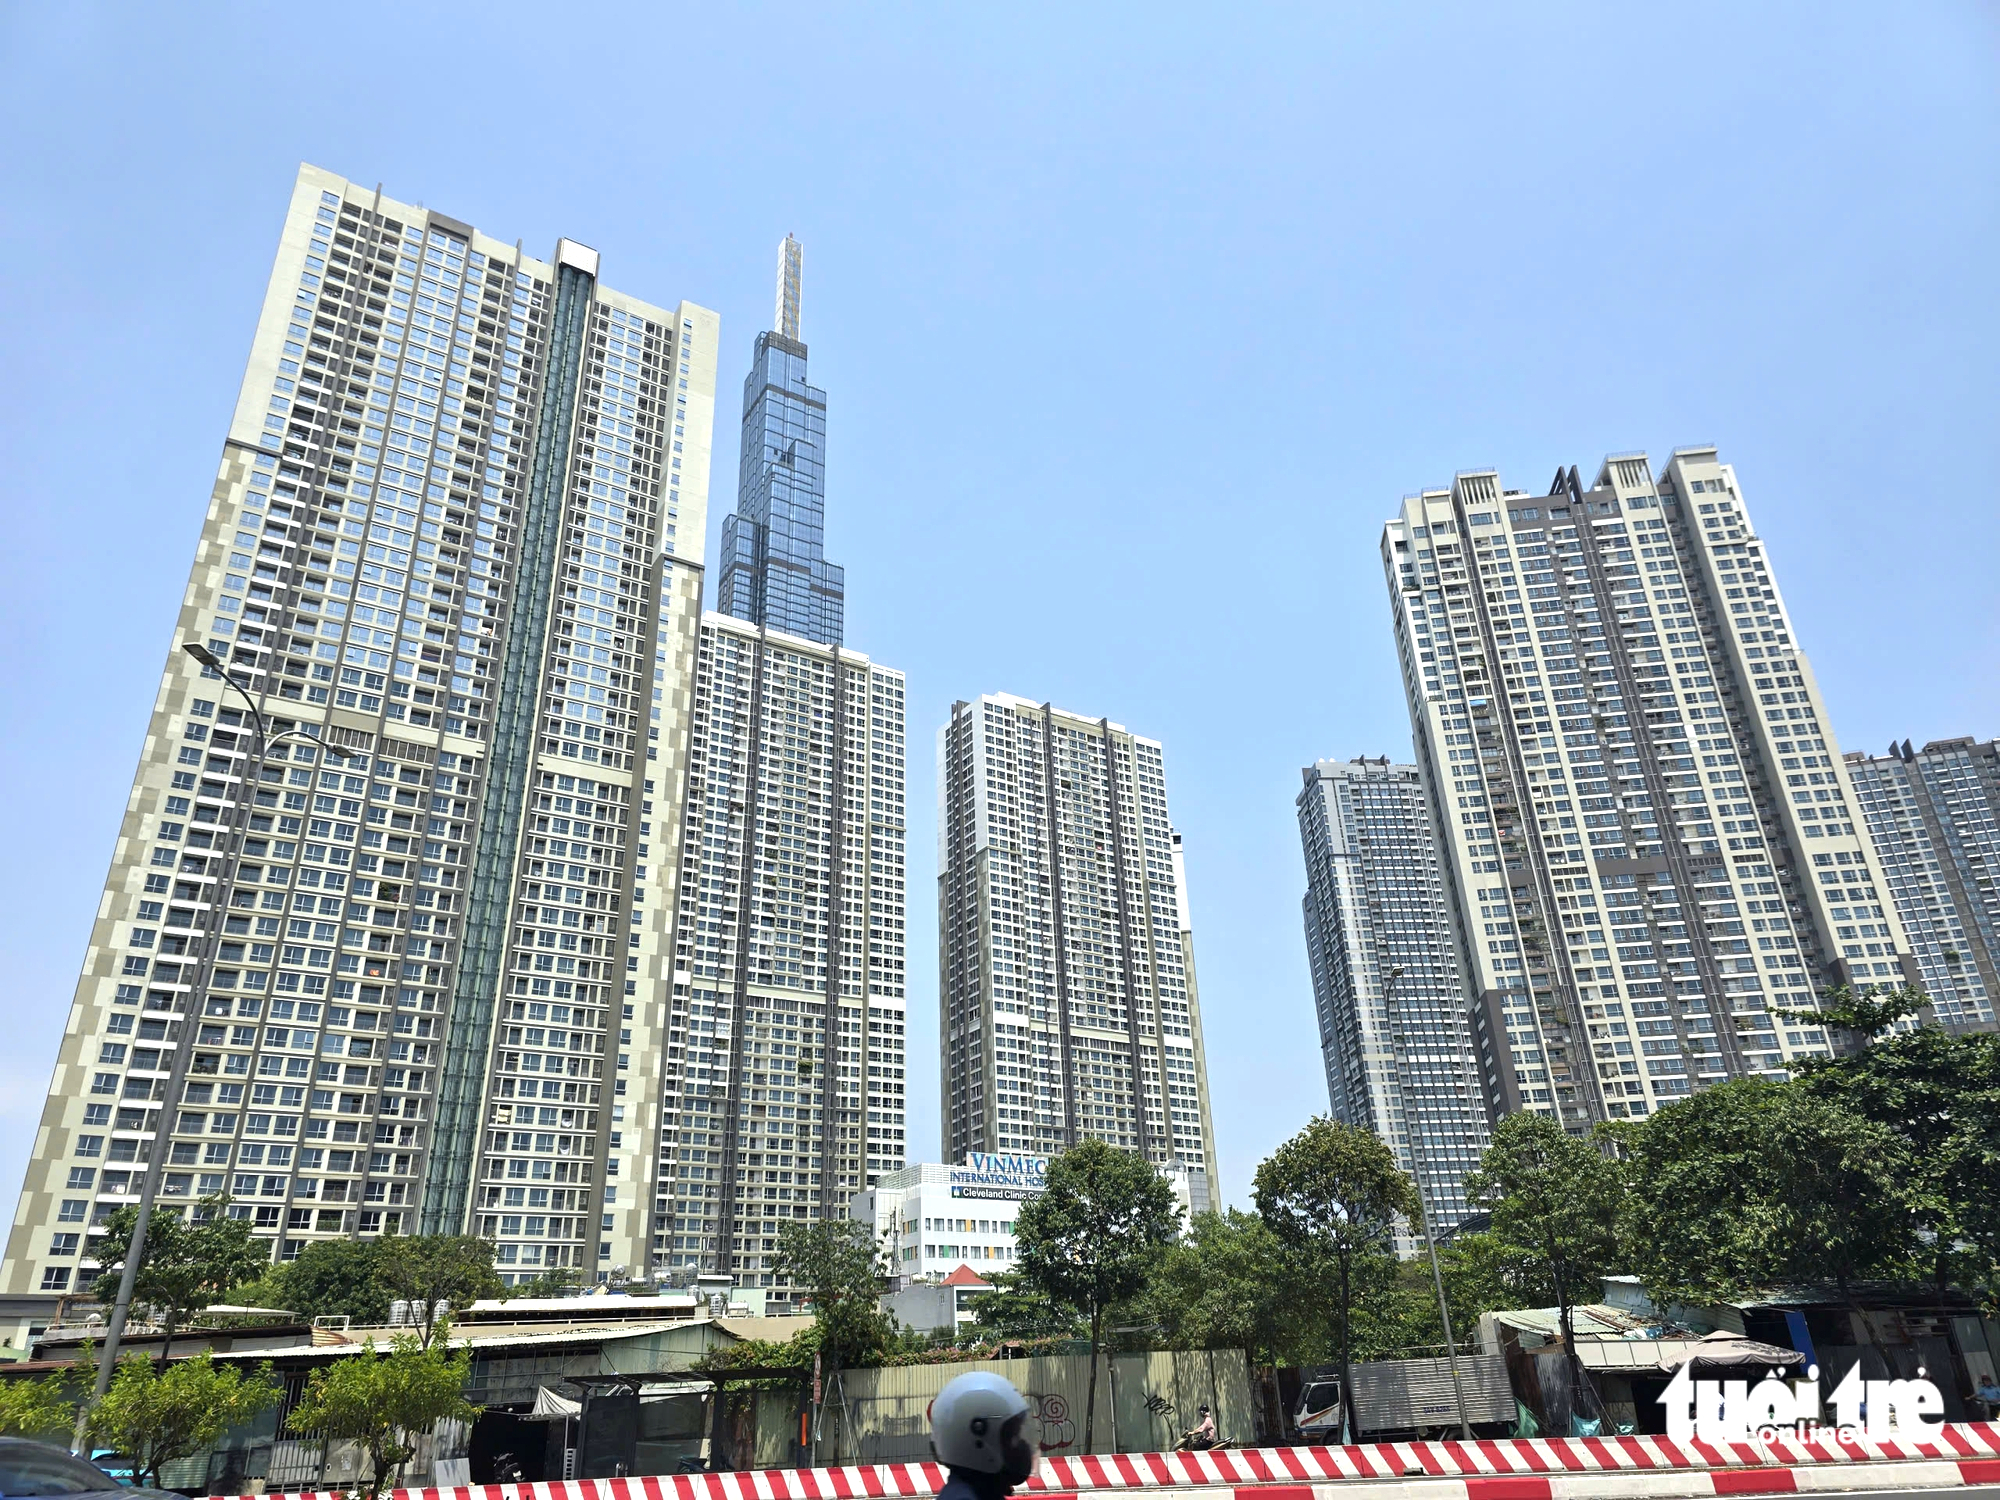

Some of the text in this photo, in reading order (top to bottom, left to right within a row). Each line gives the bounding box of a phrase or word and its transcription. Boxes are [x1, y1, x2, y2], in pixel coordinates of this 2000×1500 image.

[971, 1152, 1046, 1175] VINMEC
[950, 1172, 1044, 1187] INTERNATIONAL HOS
[963, 1188, 1003, 1199] Cleveland
[1004, 1190, 1027, 1200] Clinic
